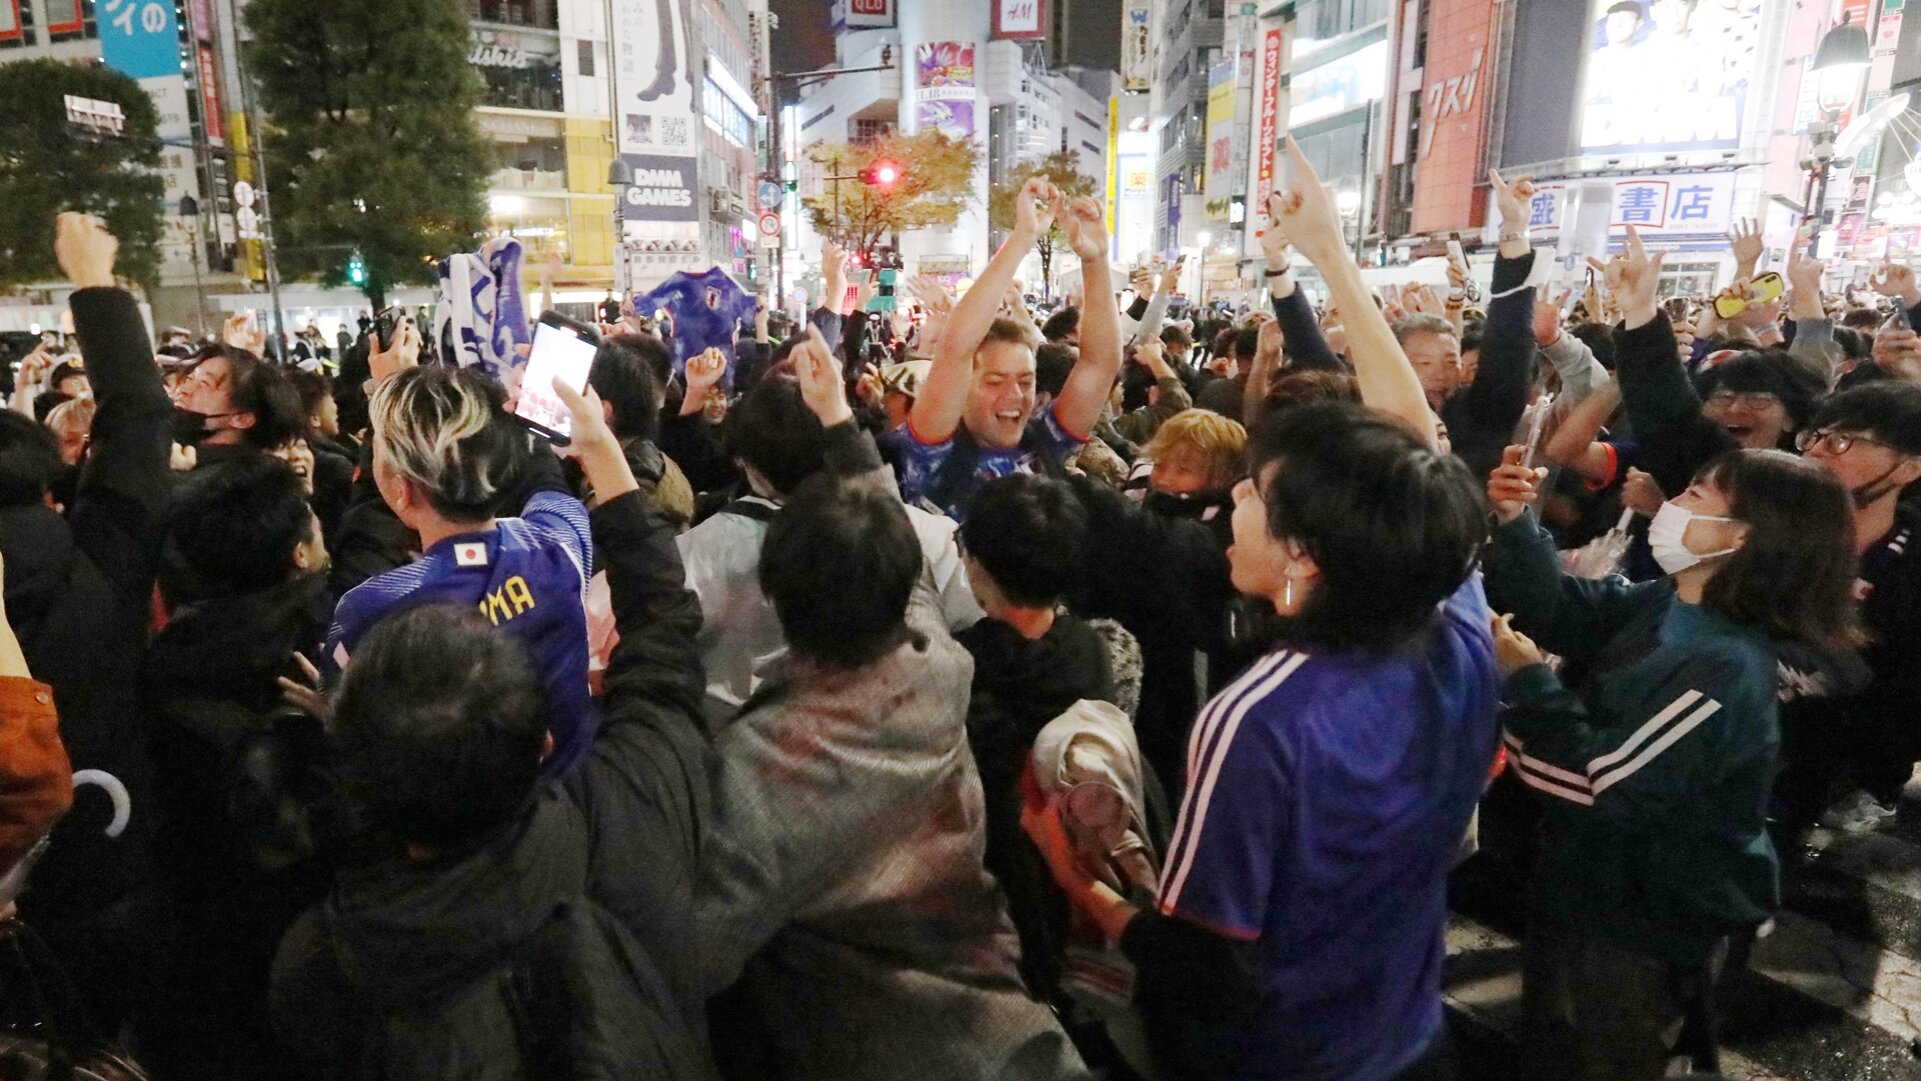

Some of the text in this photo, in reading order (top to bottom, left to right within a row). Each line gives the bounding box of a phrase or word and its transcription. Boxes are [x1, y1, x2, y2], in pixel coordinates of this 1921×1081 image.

[634, 168, 684, 187] DMM
[626, 186, 693, 206] GAMES
[1618, 186, 1715, 222] 書店
[479, 575, 536, 627] MA
